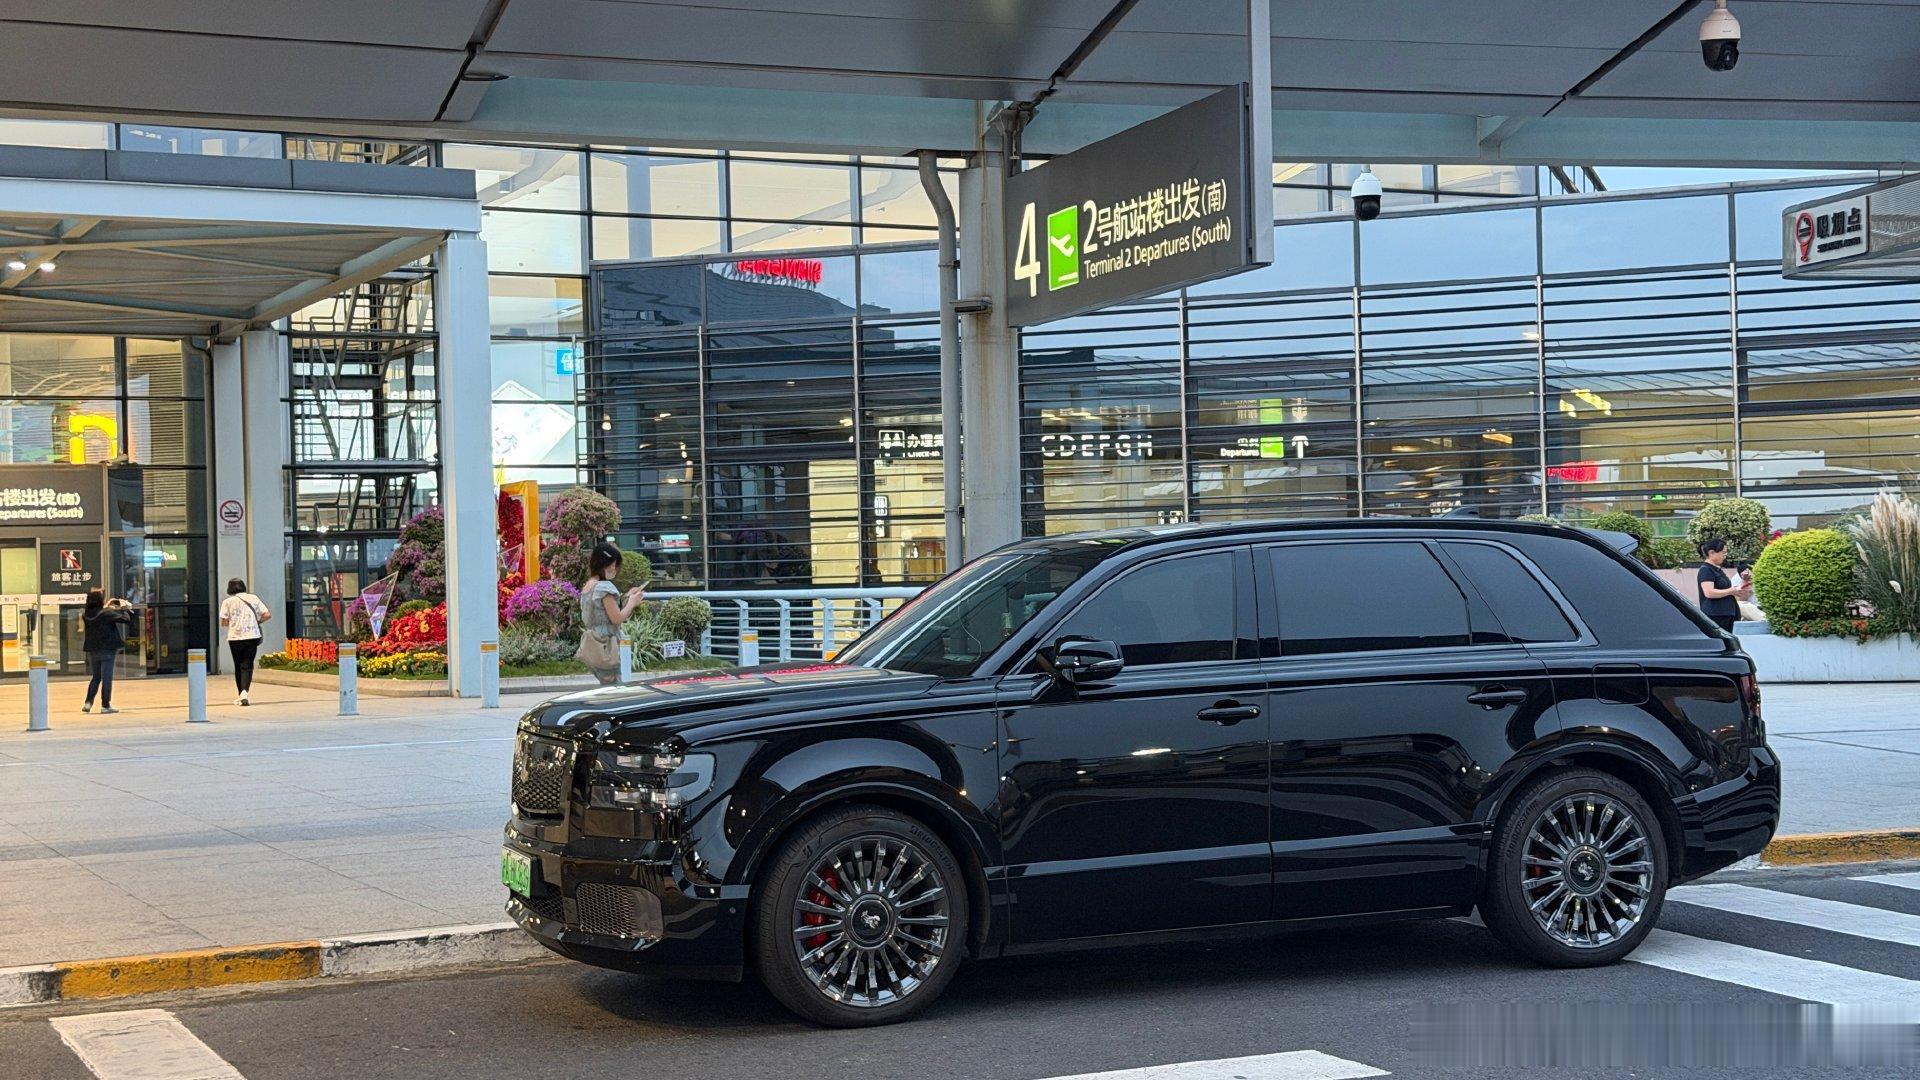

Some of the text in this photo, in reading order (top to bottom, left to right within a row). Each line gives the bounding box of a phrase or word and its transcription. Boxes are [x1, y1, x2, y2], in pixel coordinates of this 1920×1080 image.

[1014, 202, 1040, 297] 4
[1085, 216, 1231, 279] Terminal 2 Departures (South)
[1220, 448, 1259, 458] Departures
[0, 488, 80, 506] 楼出发(南)
[47, 507, 83, 519] (South)
